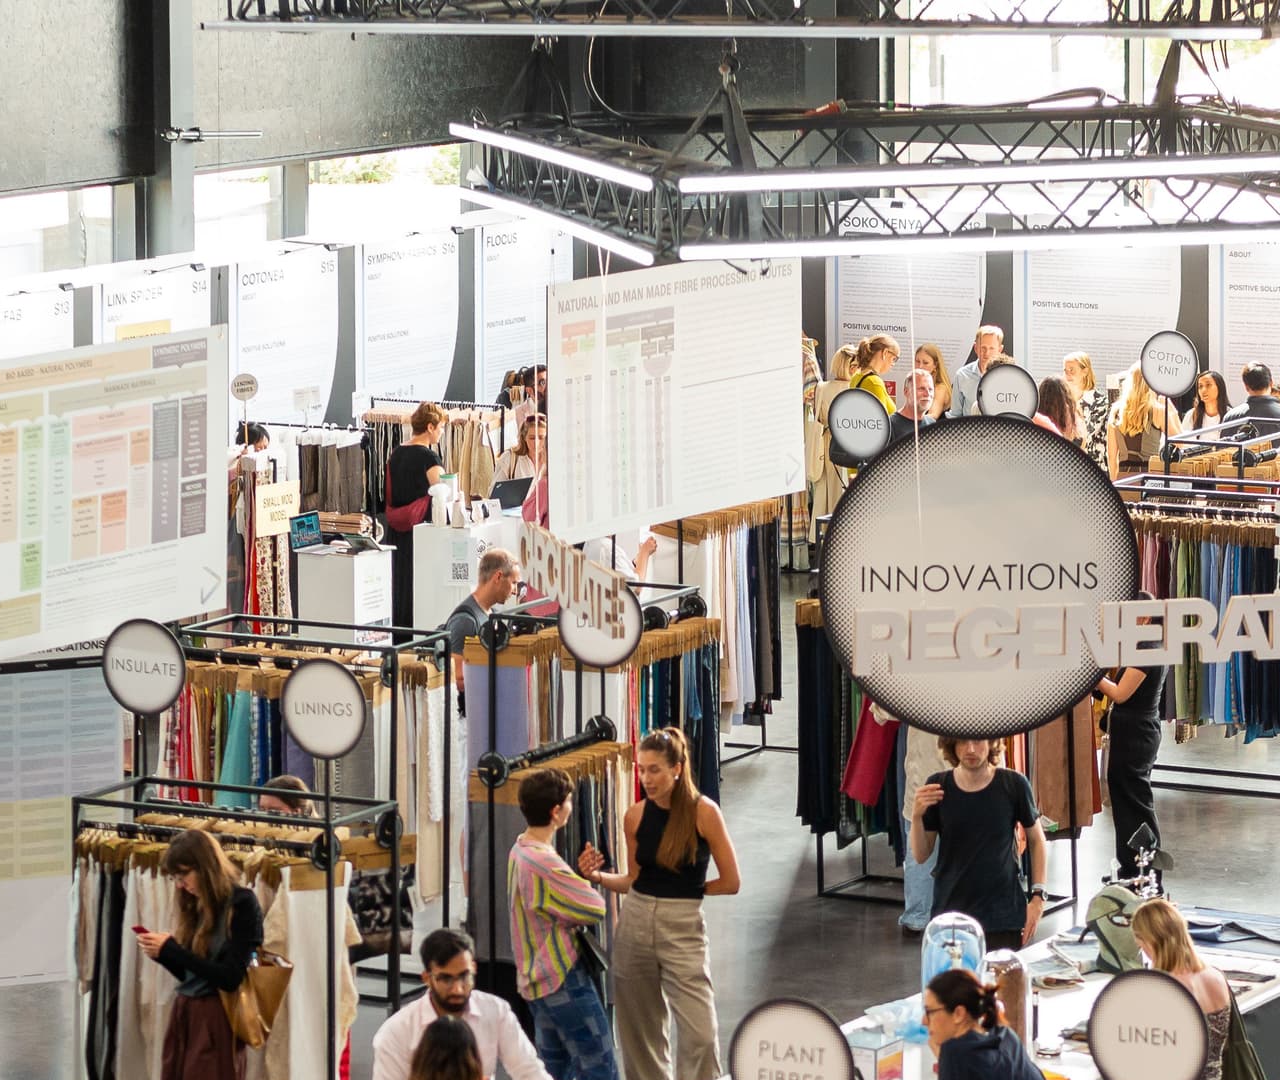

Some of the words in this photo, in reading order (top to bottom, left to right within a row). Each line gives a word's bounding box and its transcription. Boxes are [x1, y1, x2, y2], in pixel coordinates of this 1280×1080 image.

[842, 216, 879, 229] SOKO
[881, 217, 923, 231] KENYA
[486, 232, 518, 248] FLOCUS
[1228, 250, 1252, 258] ABOUT
[320, 259, 335, 274] S15
[241, 268, 285, 287] COTONEA
[192, 279, 207, 294] S14
[557, 294, 599, 316] NATURAL
[622, 290, 644, 303] MAN
[646, 283, 672, 301] MADE
[674, 278, 699, 296] FIBRE
[700, 271, 756, 291] PROCESSING
[1228, 284, 1259, 292] POSITIVE
[107, 292, 128, 307] LINK
[1032, 300, 1061, 308] POSITIVE
[1062, 301, 1099, 310] SOLUTIONS
[53, 301, 70, 317] S13
[842, 322, 870, 331] POSITIVE
[871, 323, 907, 333] SOLUTIONS
[1148, 349, 1191, 366] COTTON
[1158, 364, 1179, 377] KNIT
[996, 392, 1020, 404] CITY
[836, 417, 883, 431] LOUNGE
[516, 521, 626, 640] CIRCULATE
[860, 561, 1099, 593] INNOVATIONS
[111, 657, 178, 678] INSULATE
[294, 701, 353, 717] LININGS
[1118, 1023, 1177, 1047] LINEN
[758, 1038, 825, 1066] PLANT
